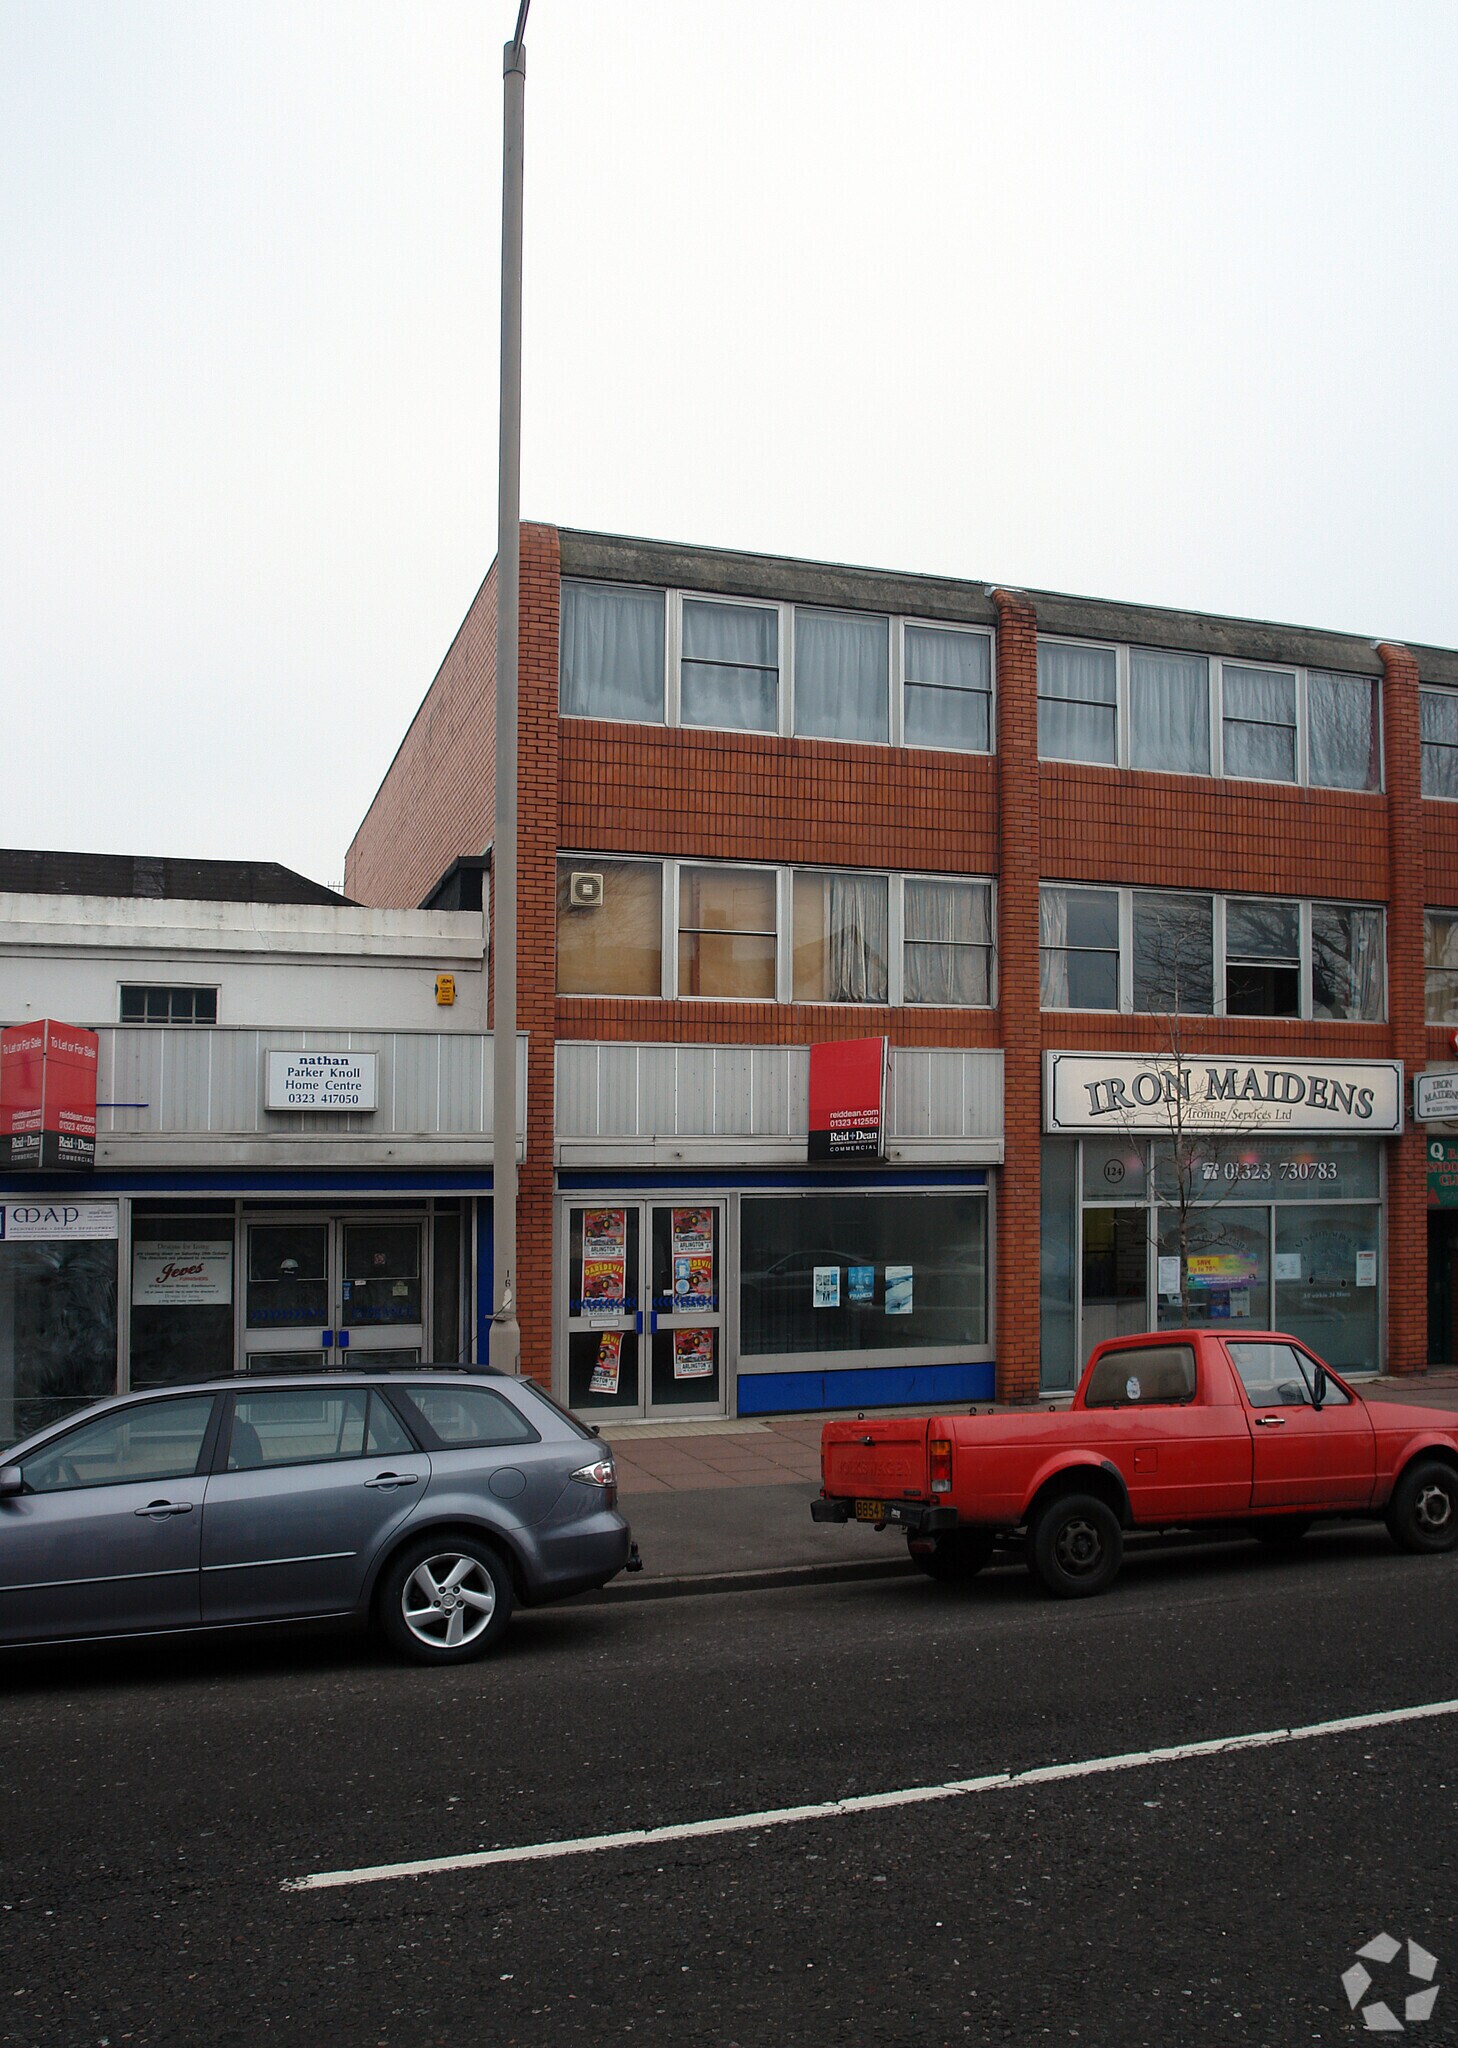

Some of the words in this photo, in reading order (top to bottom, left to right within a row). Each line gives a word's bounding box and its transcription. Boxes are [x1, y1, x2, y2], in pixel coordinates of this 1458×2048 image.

[31, 1037, 42, 1048] Sale
[51, 1036, 58, 1048] To
[59, 1038, 67, 1050] Let
[68, 1044, 74, 1052] or
[75, 1044, 83, 1054] For
[84, 1046, 96, 1058] Sale
[299, 1056, 349, 1066] nathan
[288, 1067, 324, 1077] Parker
[330, 1068, 360, 1078] Knoll
[286, 1080, 319, 1090] Home
[325, 1080, 362, 1090] Centre
[1432, 1080, 1453, 1090] IRON
[1084, 1069, 1192, 1116] IRON
[1204, 1068, 1375, 1119] MAIDENS
[288, 1094, 315, 1104] 0323
[321, 1094, 358, 1104] 417050
[60, 1111, 95, 1122] reiddean.com
[830, 1109, 878, 1118] reiddean.com
[1187, 1109, 1226, 1120] Ironing
[1232, 1109, 1272, 1120] Services
[1276, 1109, 1292, 1120] Ltd
[830, 1118, 851, 1127] 01323
[852, 1117, 878, 1126] 412550
[11, 1152, 38, 1160] COMMERCIAL
[1430, 1142, 1444, 1160] Q
[58, 1154, 93, 1164] COMMERCIAL
[1106, 1168, 1122, 1176] 124
[1224, 1162, 1271, 1180] 01323
[1280, 1162, 1338, 1180] 730783
[584, 1262, 624, 1276] DAREDEVIL
